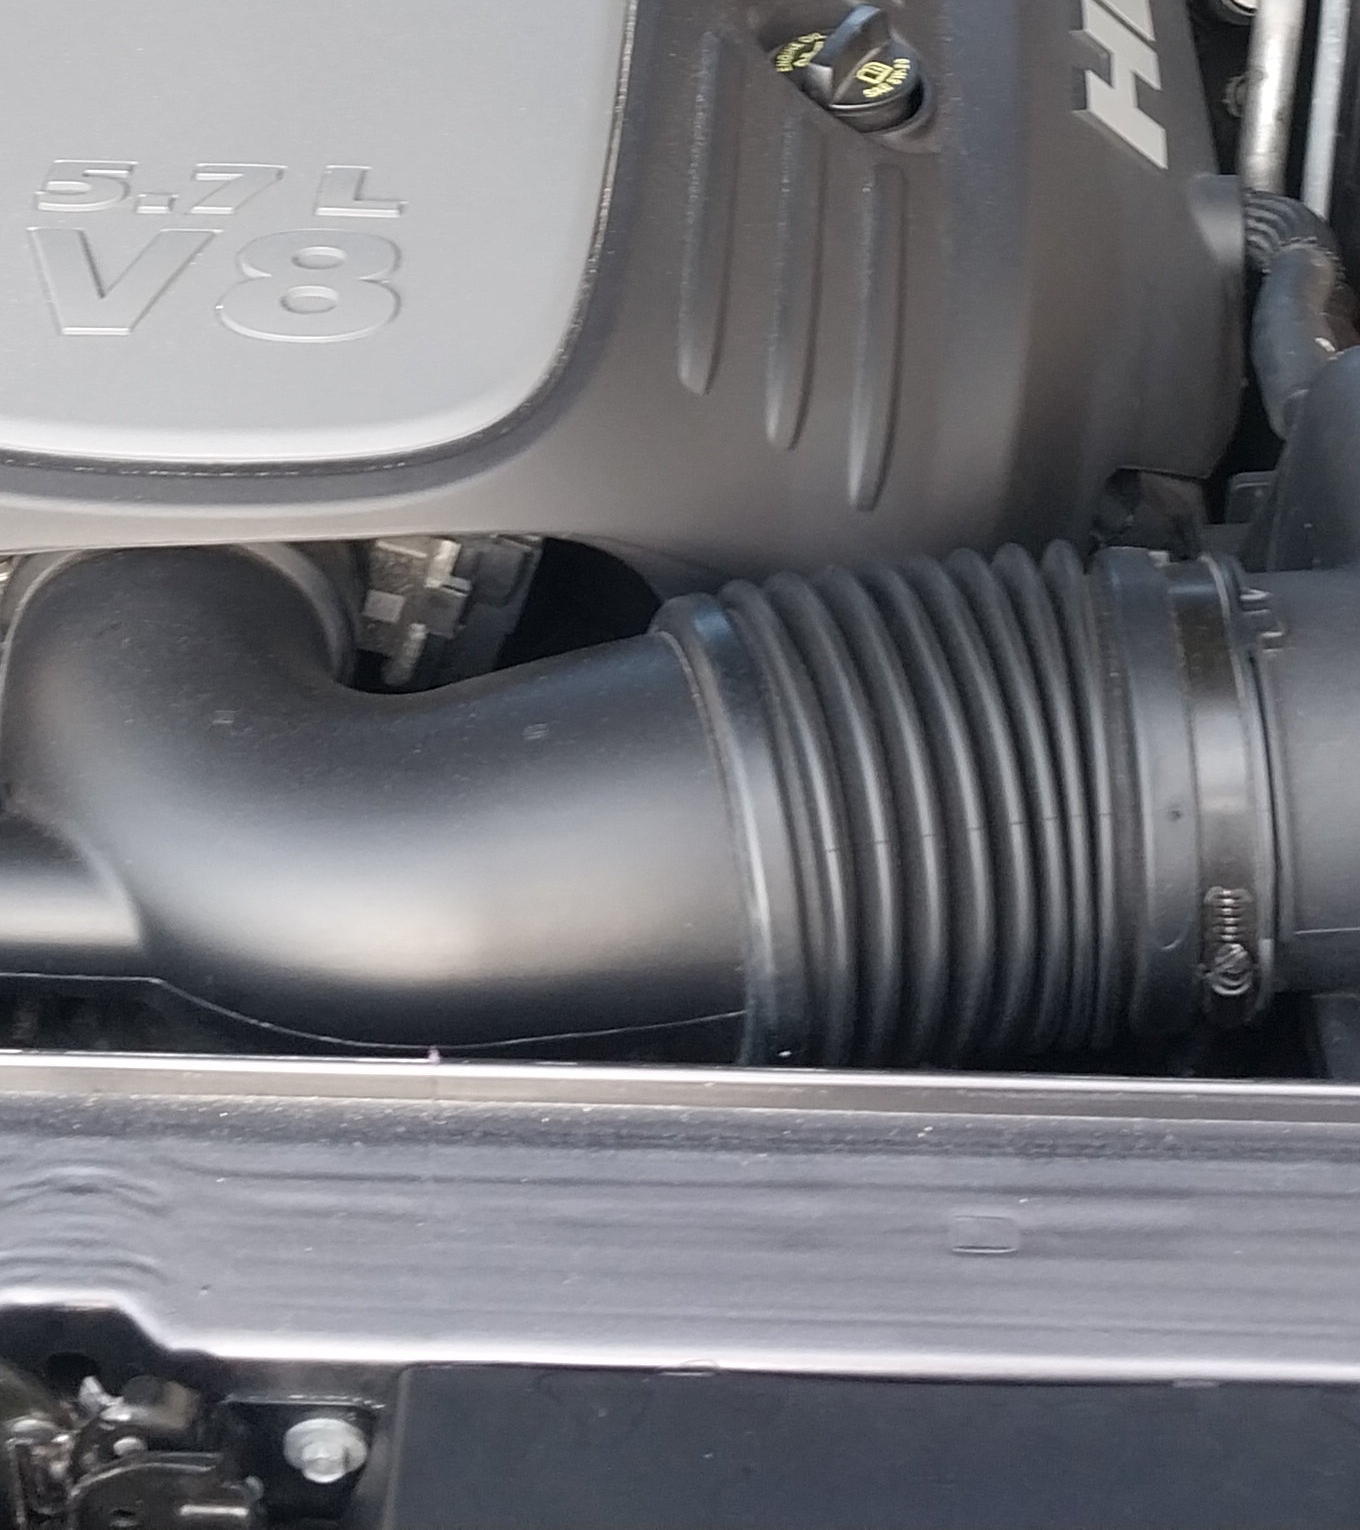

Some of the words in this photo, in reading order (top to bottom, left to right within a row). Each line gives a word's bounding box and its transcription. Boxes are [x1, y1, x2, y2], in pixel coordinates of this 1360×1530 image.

[34, 158, 288, 214] 5.7
[314, 164, 410, 219] L
[26, 226, 403, 344] V8
